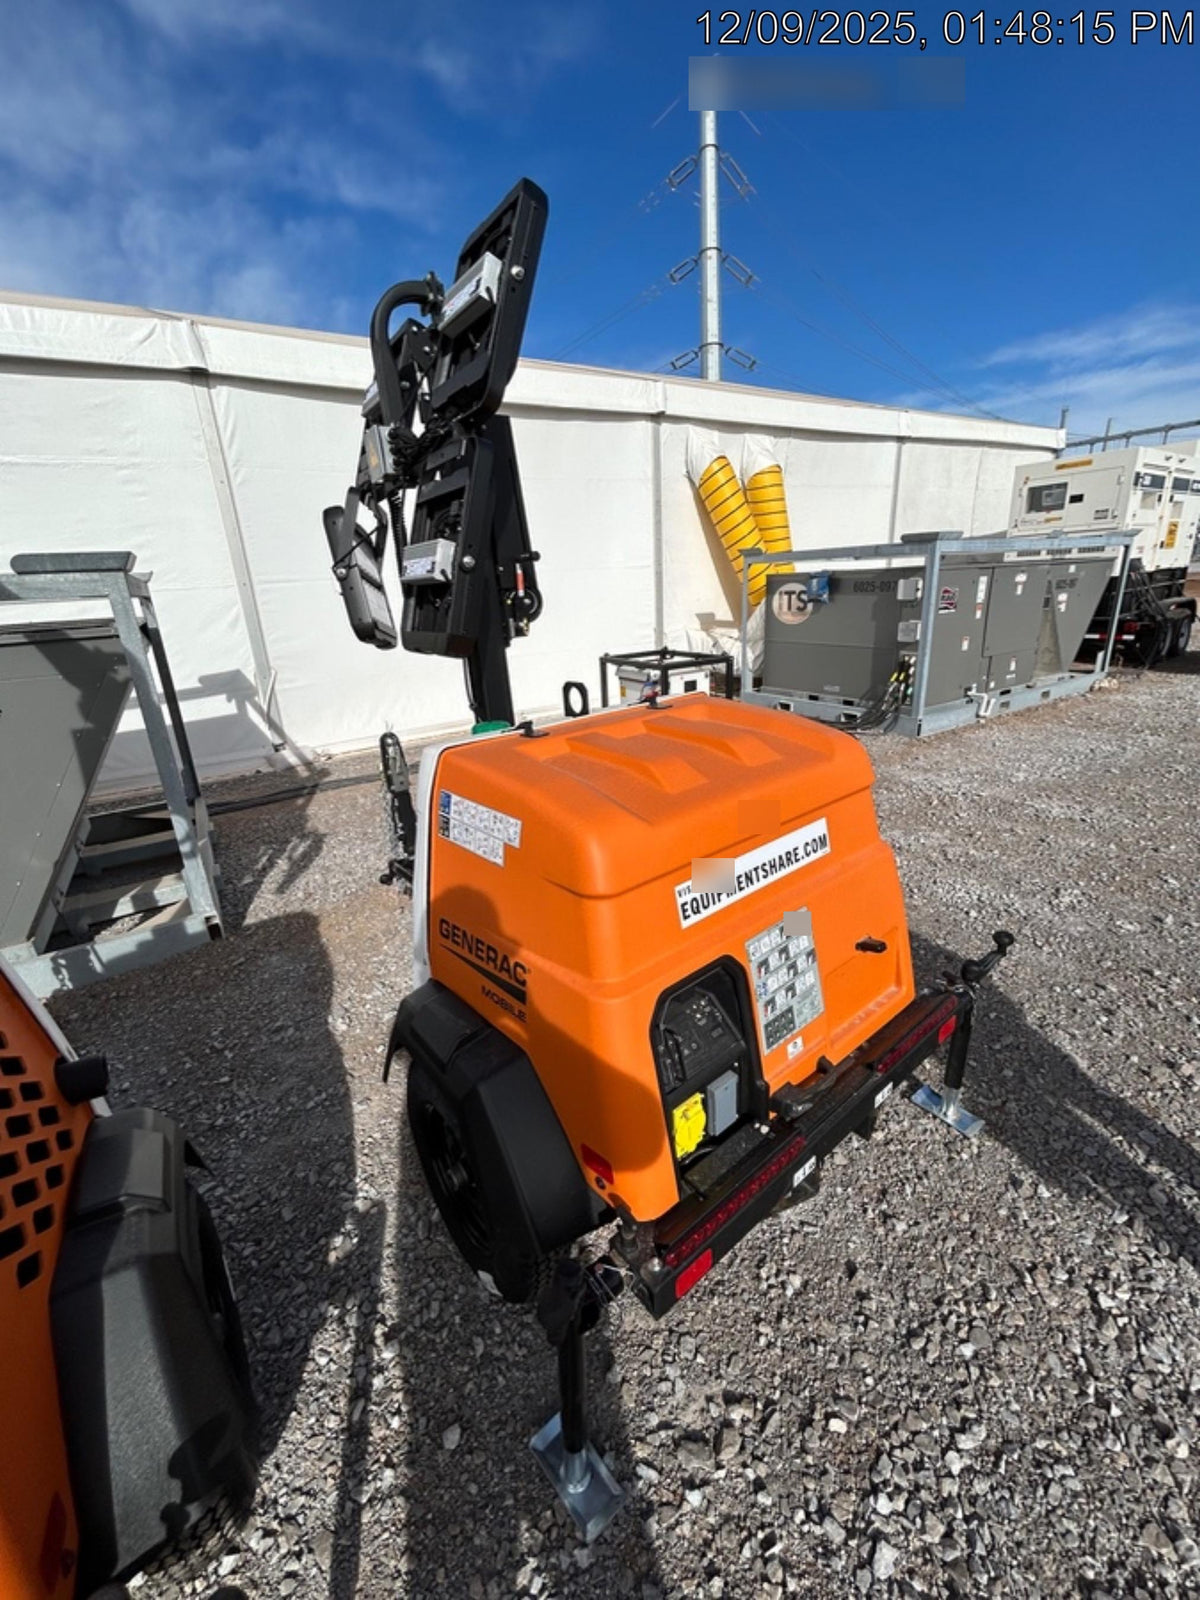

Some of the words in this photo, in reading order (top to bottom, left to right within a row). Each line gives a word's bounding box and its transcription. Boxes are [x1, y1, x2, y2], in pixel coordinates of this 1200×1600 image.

[680, 833, 828, 921] EQUIPENTSHARE.COM
[439, 917, 527, 988] GENERAC
[481, 985, 527, 1023] MOBILE
